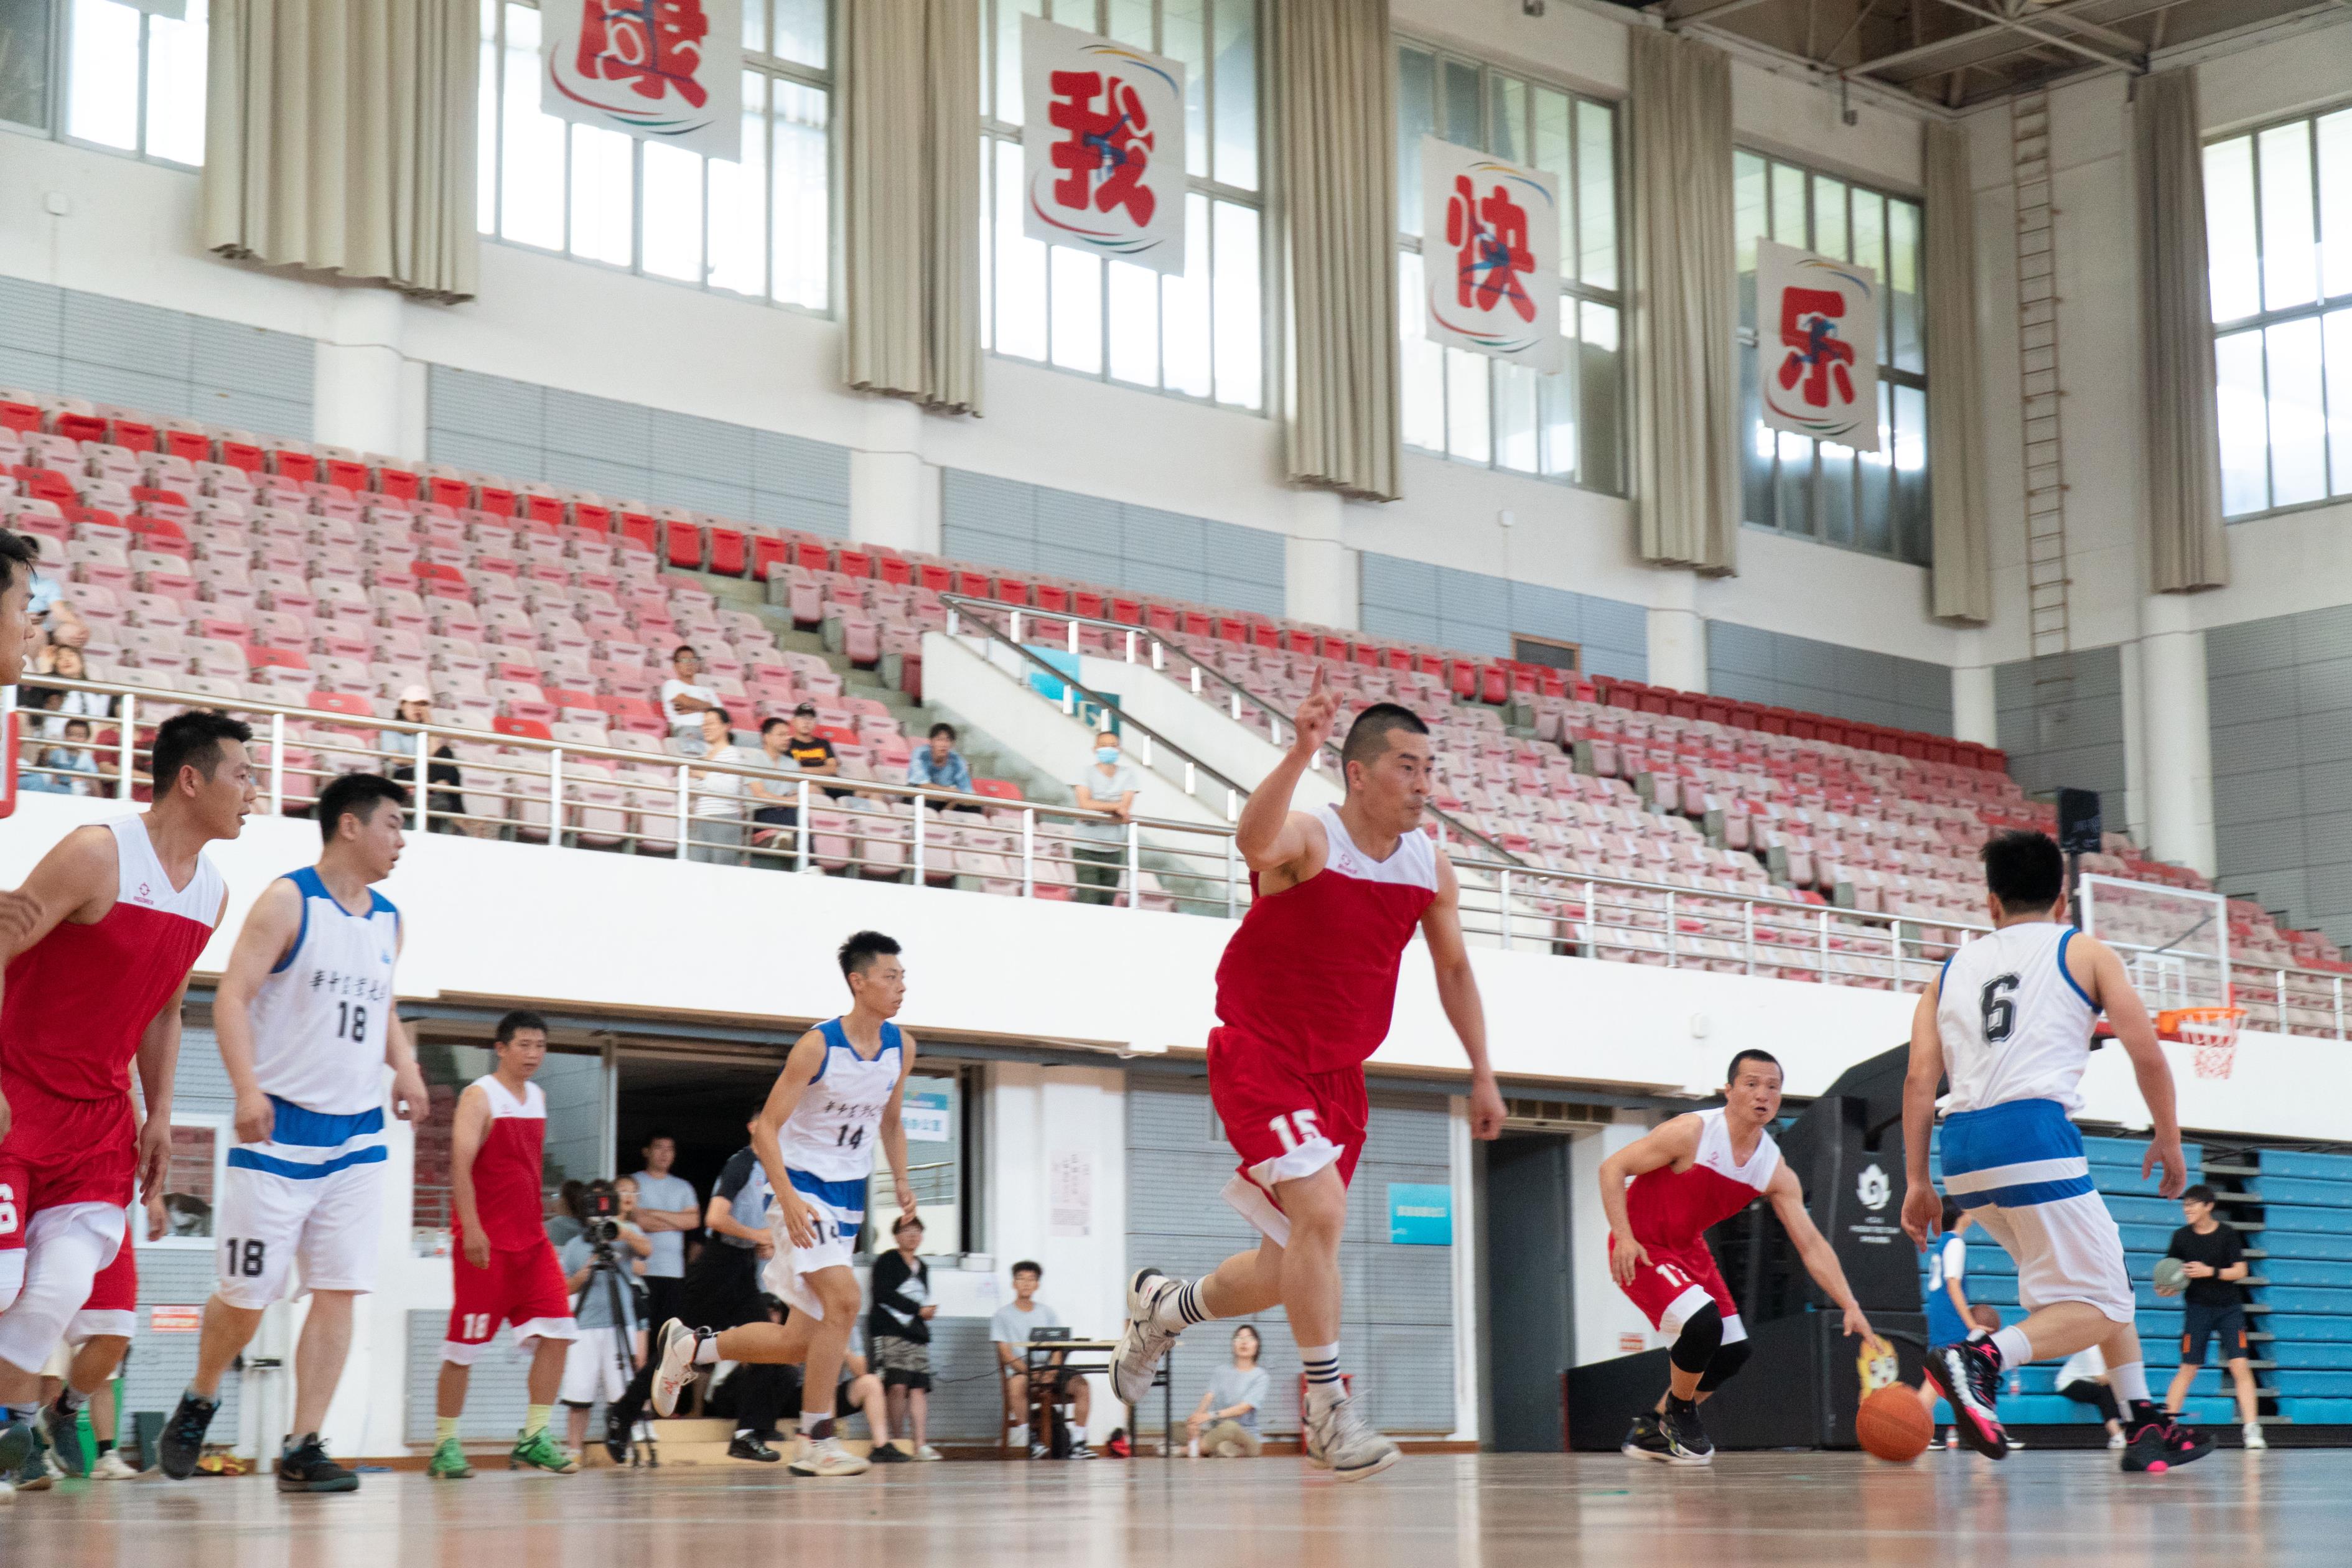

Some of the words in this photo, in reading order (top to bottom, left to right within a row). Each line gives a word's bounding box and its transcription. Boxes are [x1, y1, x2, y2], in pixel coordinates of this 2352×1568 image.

[1049, 70, 1155, 227] 我
[1446, 174, 1536, 322] 快
[1779, 287, 1855, 406] 乐
[337, 1000, 366, 1043] 18
[1981, 972, 2020, 1043] 6
[838, 1124, 864, 1149] 14
[1269, 1109, 1322, 1152] 15
[0, 1183, 18, 1234] 6
[226, 1238, 264, 1277] 18
